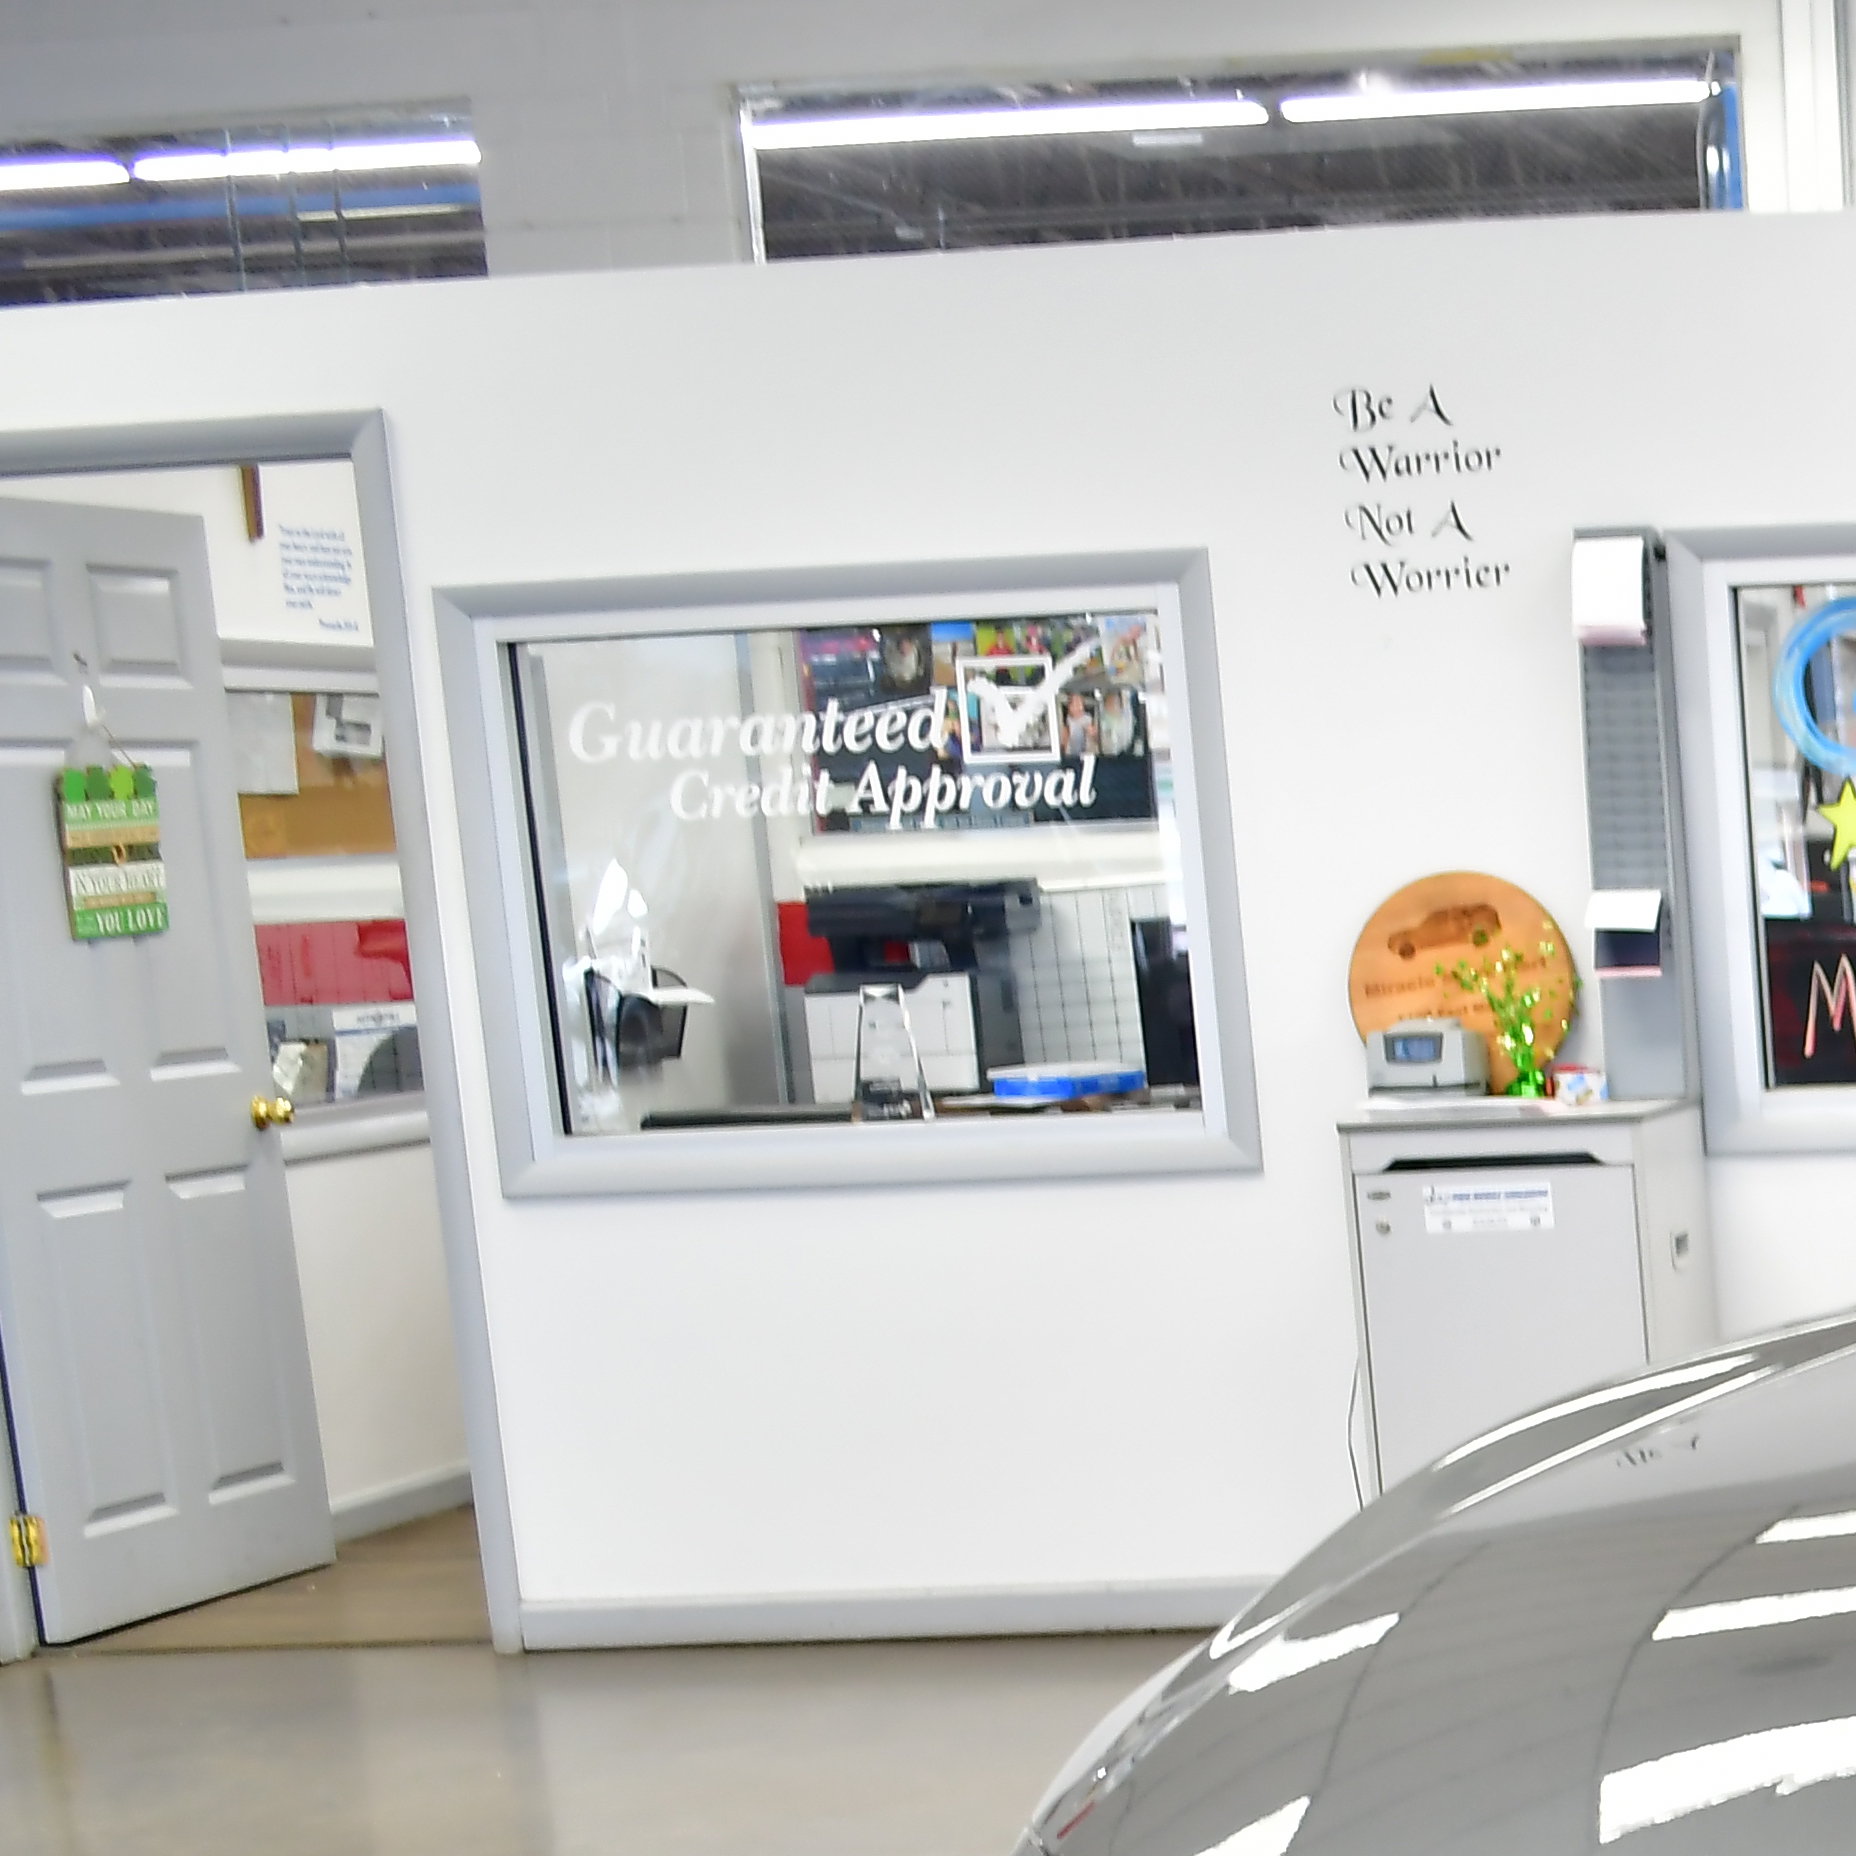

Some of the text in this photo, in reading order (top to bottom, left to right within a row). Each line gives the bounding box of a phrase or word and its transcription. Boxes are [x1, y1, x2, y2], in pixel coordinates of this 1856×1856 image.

[1333, 383, 1453, 432] Be A
[1339, 439, 1501, 484] Warrior
[1344, 499, 1474, 547] Not A
[1350, 555, 1510, 599] Worrier
[568, 684, 950, 764] Guaranteed
[670, 754, 1099, 830] Credit Approval
